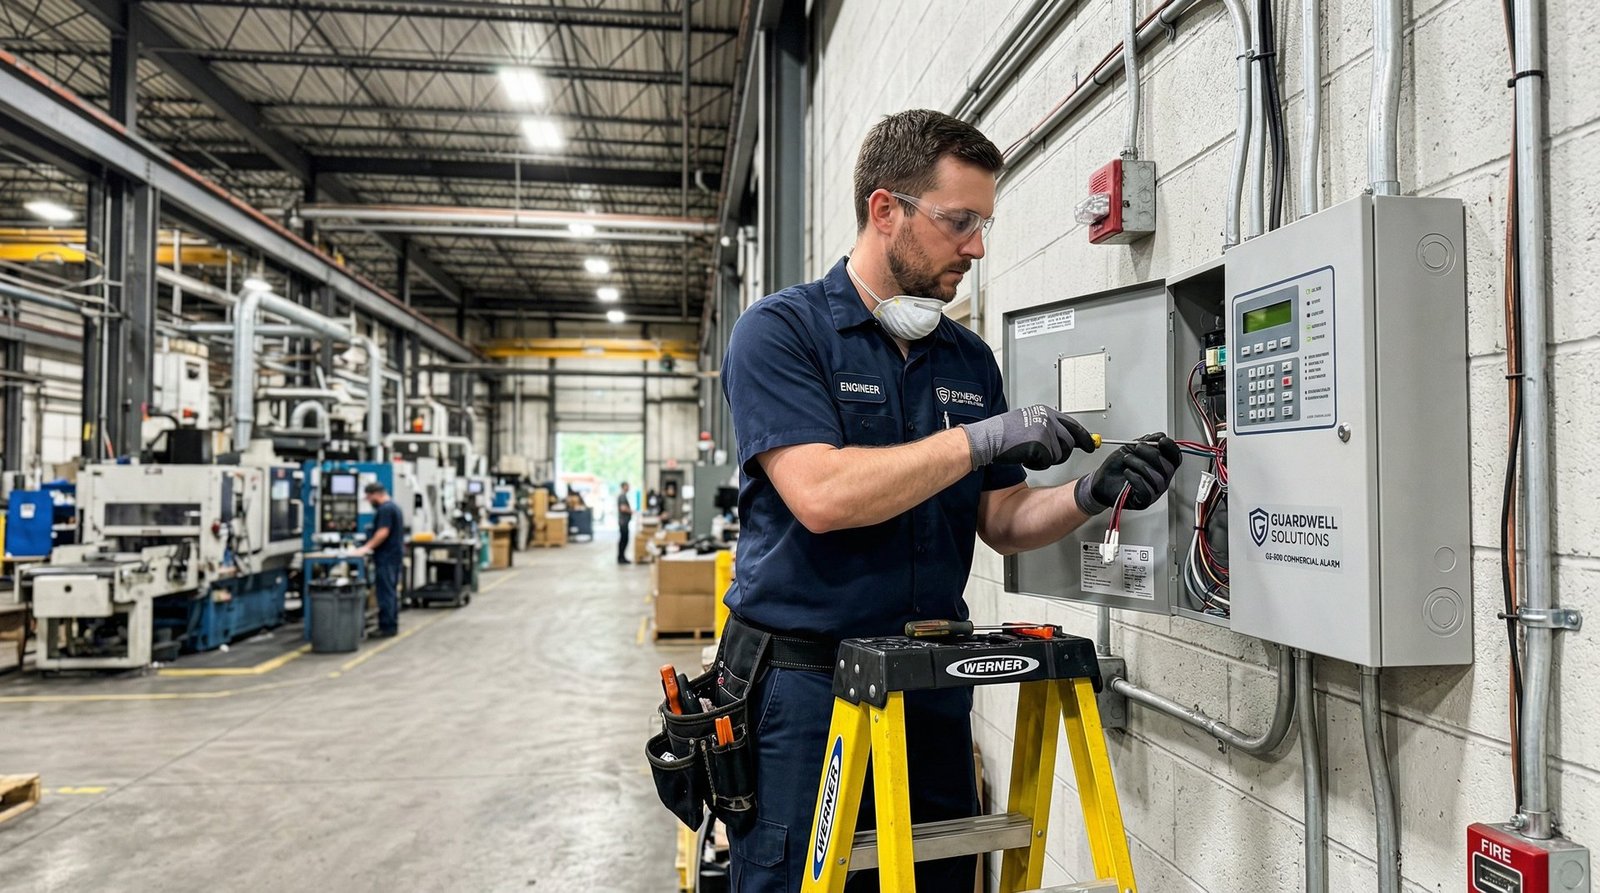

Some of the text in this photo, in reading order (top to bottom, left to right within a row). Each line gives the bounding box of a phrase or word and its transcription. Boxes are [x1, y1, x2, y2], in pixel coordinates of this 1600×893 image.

[840, 382, 880, 394] ENGINEER
[952, 390, 983, 402] SYNERGY
[1271, 514, 1338, 530] GUARDWELL
[1272, 530, 1330, 546] SOLUTIONS
[1284, 555, 1318, 566] COMMERCIAL
[1320, 559, 1340, 568] ALARM
[964, 660, 1022, 674] WERNER
[818, 764, 838, 854] WERNER
[1481, 838, 1512, 864] FIRE
